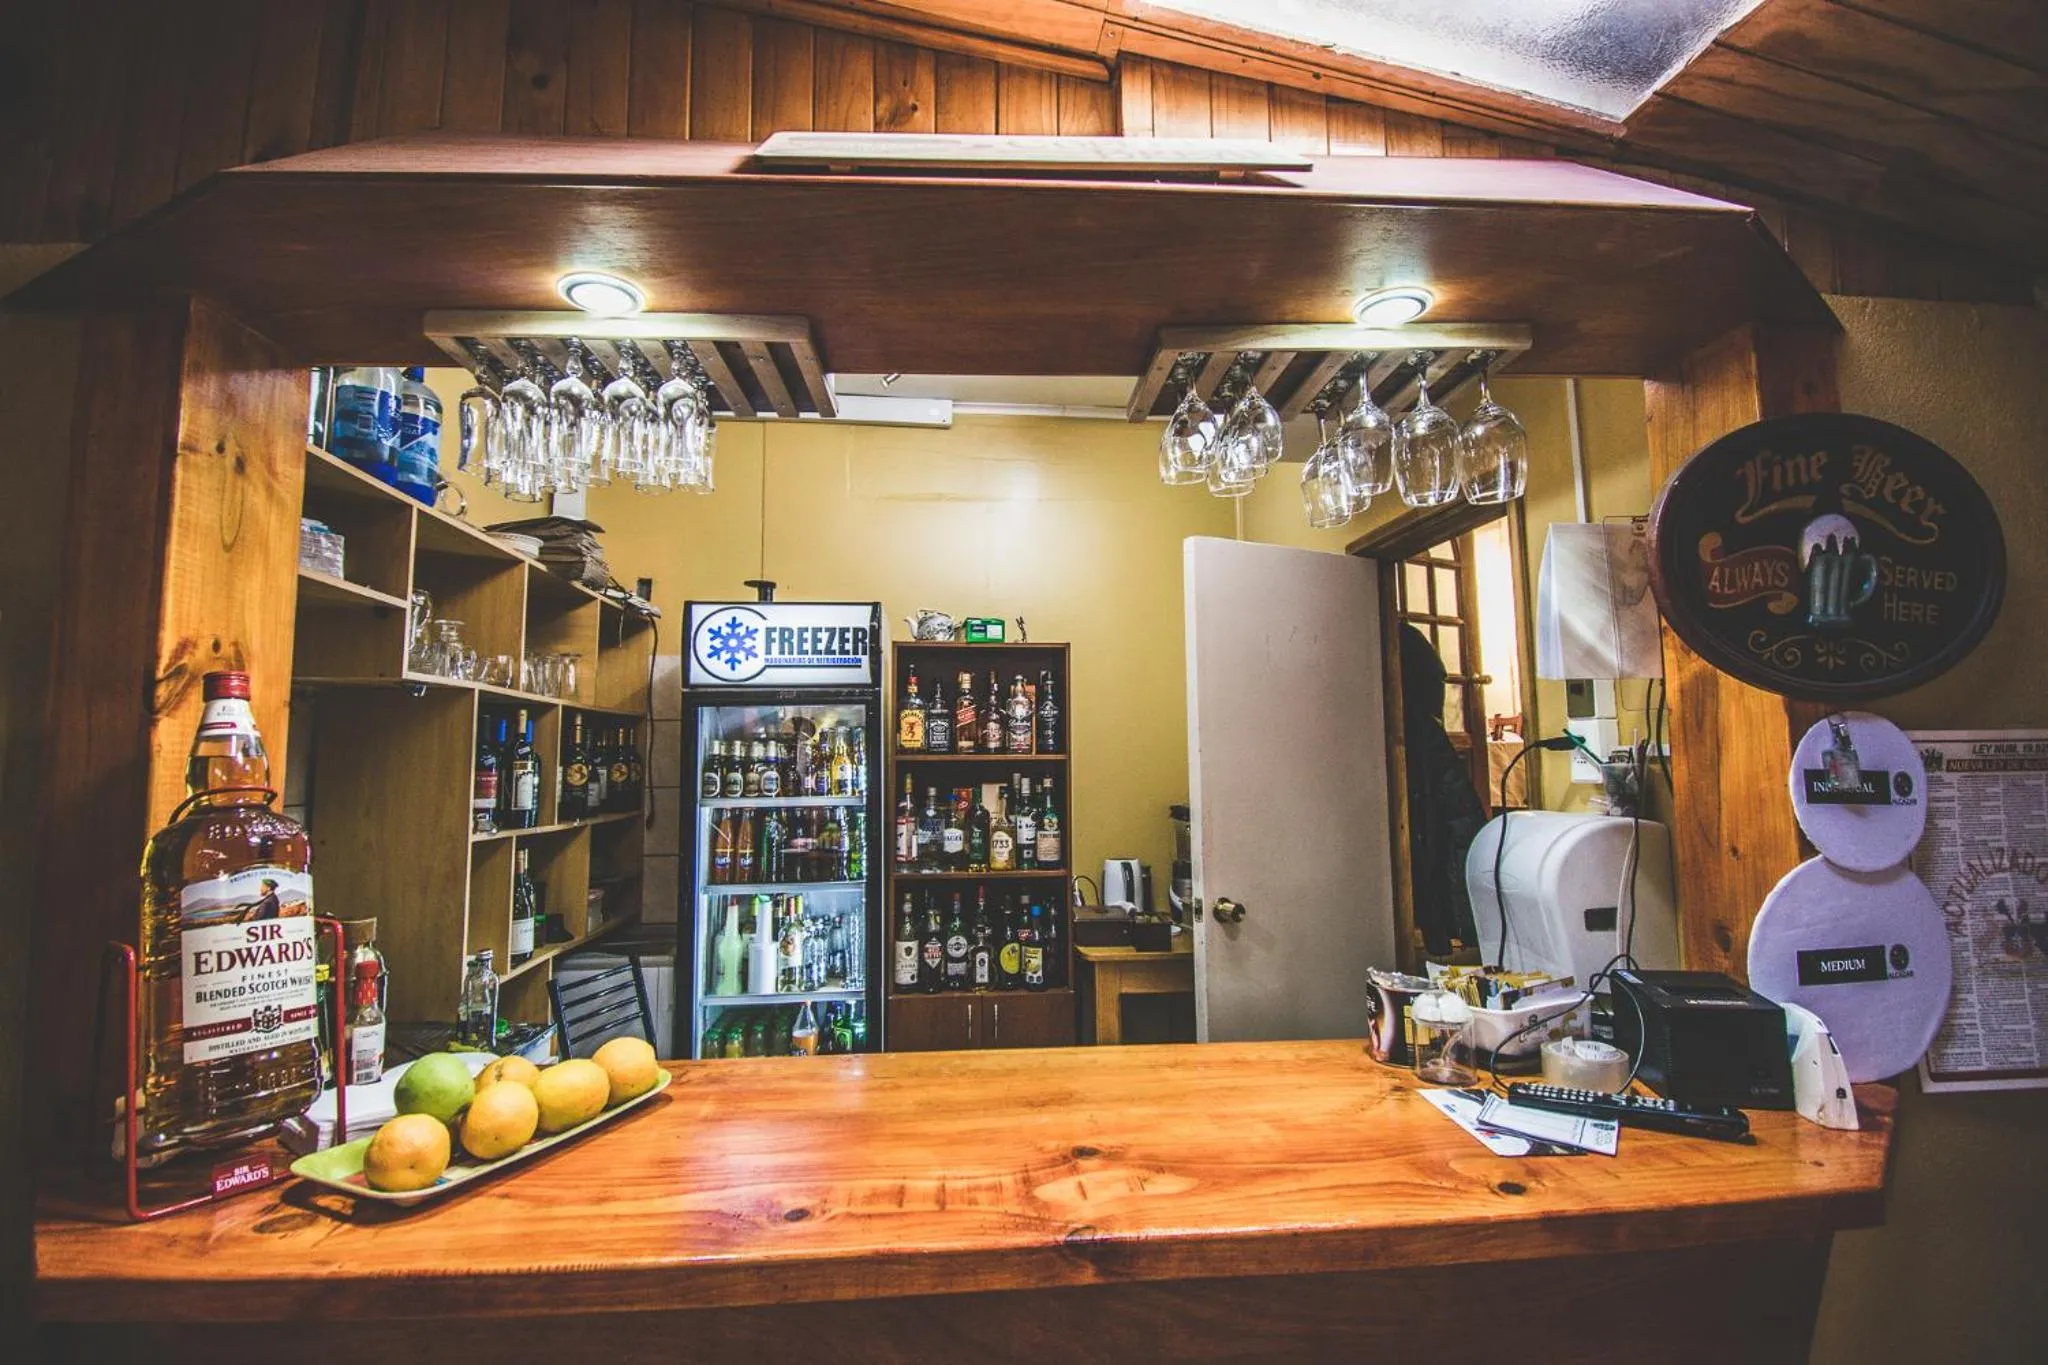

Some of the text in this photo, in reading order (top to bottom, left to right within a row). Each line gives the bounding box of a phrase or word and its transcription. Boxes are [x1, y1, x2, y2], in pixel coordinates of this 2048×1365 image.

[1735, 445, 1947, 525] Fine Beer
[1708, 558, 1790, 595] ALWAYS
[1879, 556, 1958, 593] SERVED
[1883, 594, 1939, 625] HERE
[765, 627, 868, 656] FREEZER
[246, 923, 284, 944] SIR
[192, 936, 314, 977] EDWARD'S
[1820, 958, 1866, 973] MEDIUM
[241, 968, 289, 983] FINEST
[195, 985, 246, 1004] BLENDED
[248, 977, 289, 995] SCOTCH
[216, 1166, 270, 1192] EDWARD'S
